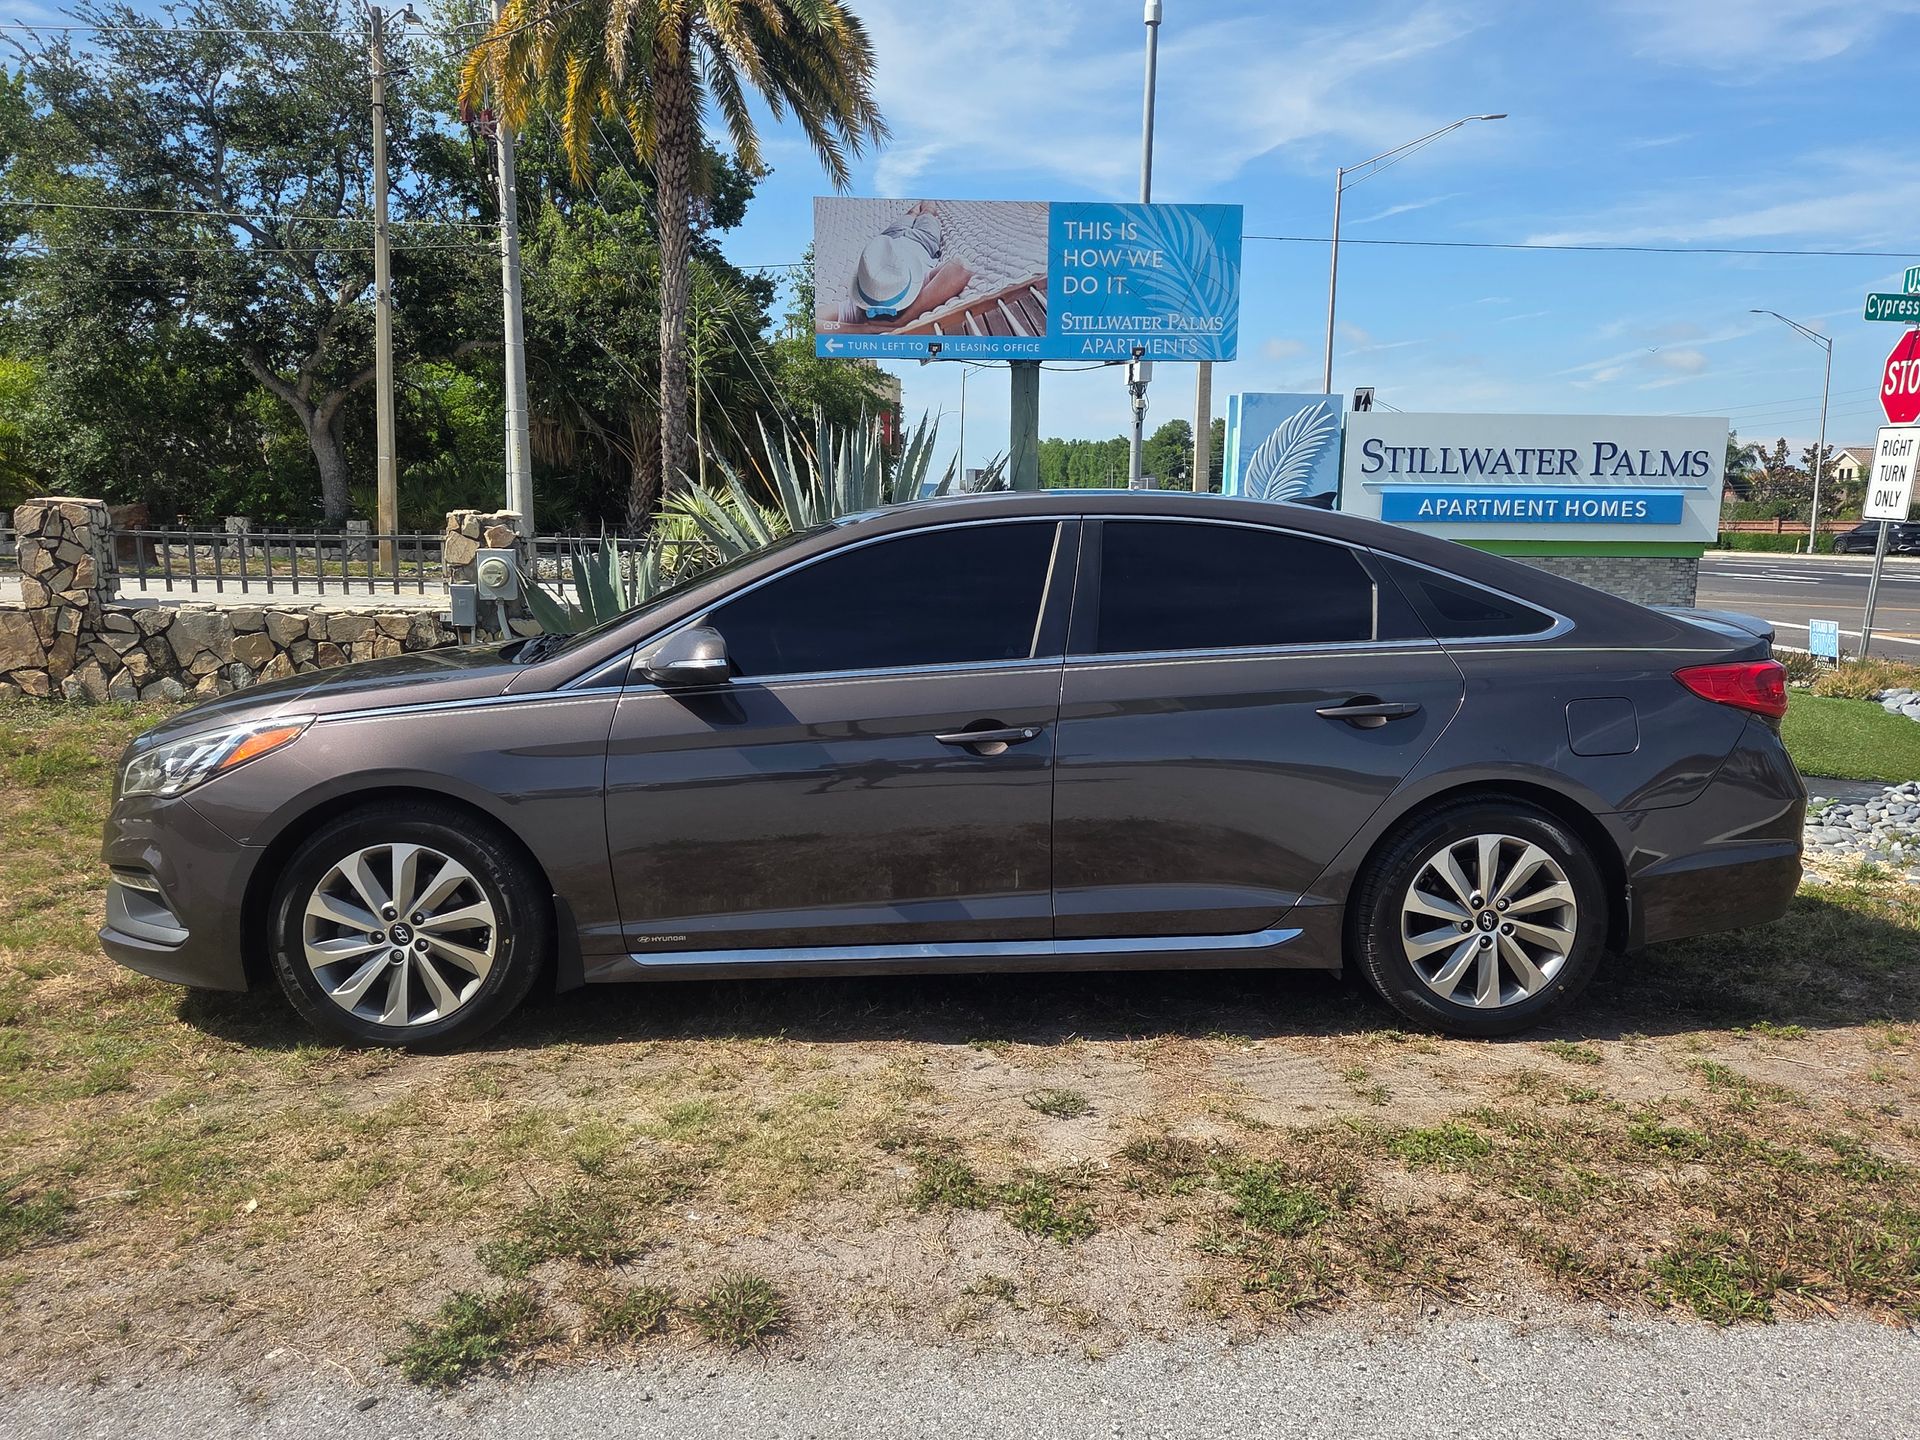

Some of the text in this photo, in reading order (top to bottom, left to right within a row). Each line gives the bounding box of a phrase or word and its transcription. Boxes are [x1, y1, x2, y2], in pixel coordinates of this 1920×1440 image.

[1063, 221, 1138, 240] THIS IS
[1064, 249, 1163, 268] HOW WE
[1063, 276, 1130, 295] DO IT.
[1908, 268, 1920, 293] U
[1867, 295, 1920, 319] Cypress
[1061, 312, 1224, 332] STILLWATER PALMS
[847, 341, 877, 351] TURN
[882, 342, 906, 351] LEFT
[909, 342, 924, 351] TO
[955, 343, 999, 352] LEASING
[1003, 343, 1040, 352] OFFICE
[1081, 338, 1199, 355] APARTMENTS
[1881, 439, 1914, 457] RIGHT
[1360, 438, 1710, 478] STILLWATER PALMS
[1879, 464, 1908, 482] TURN
[1418, 498, 1649, 519] APARTMENT HOMES
[1874, 490, 1902, 508] ONLY
[1812, 633, 1835, 655] GUYS
